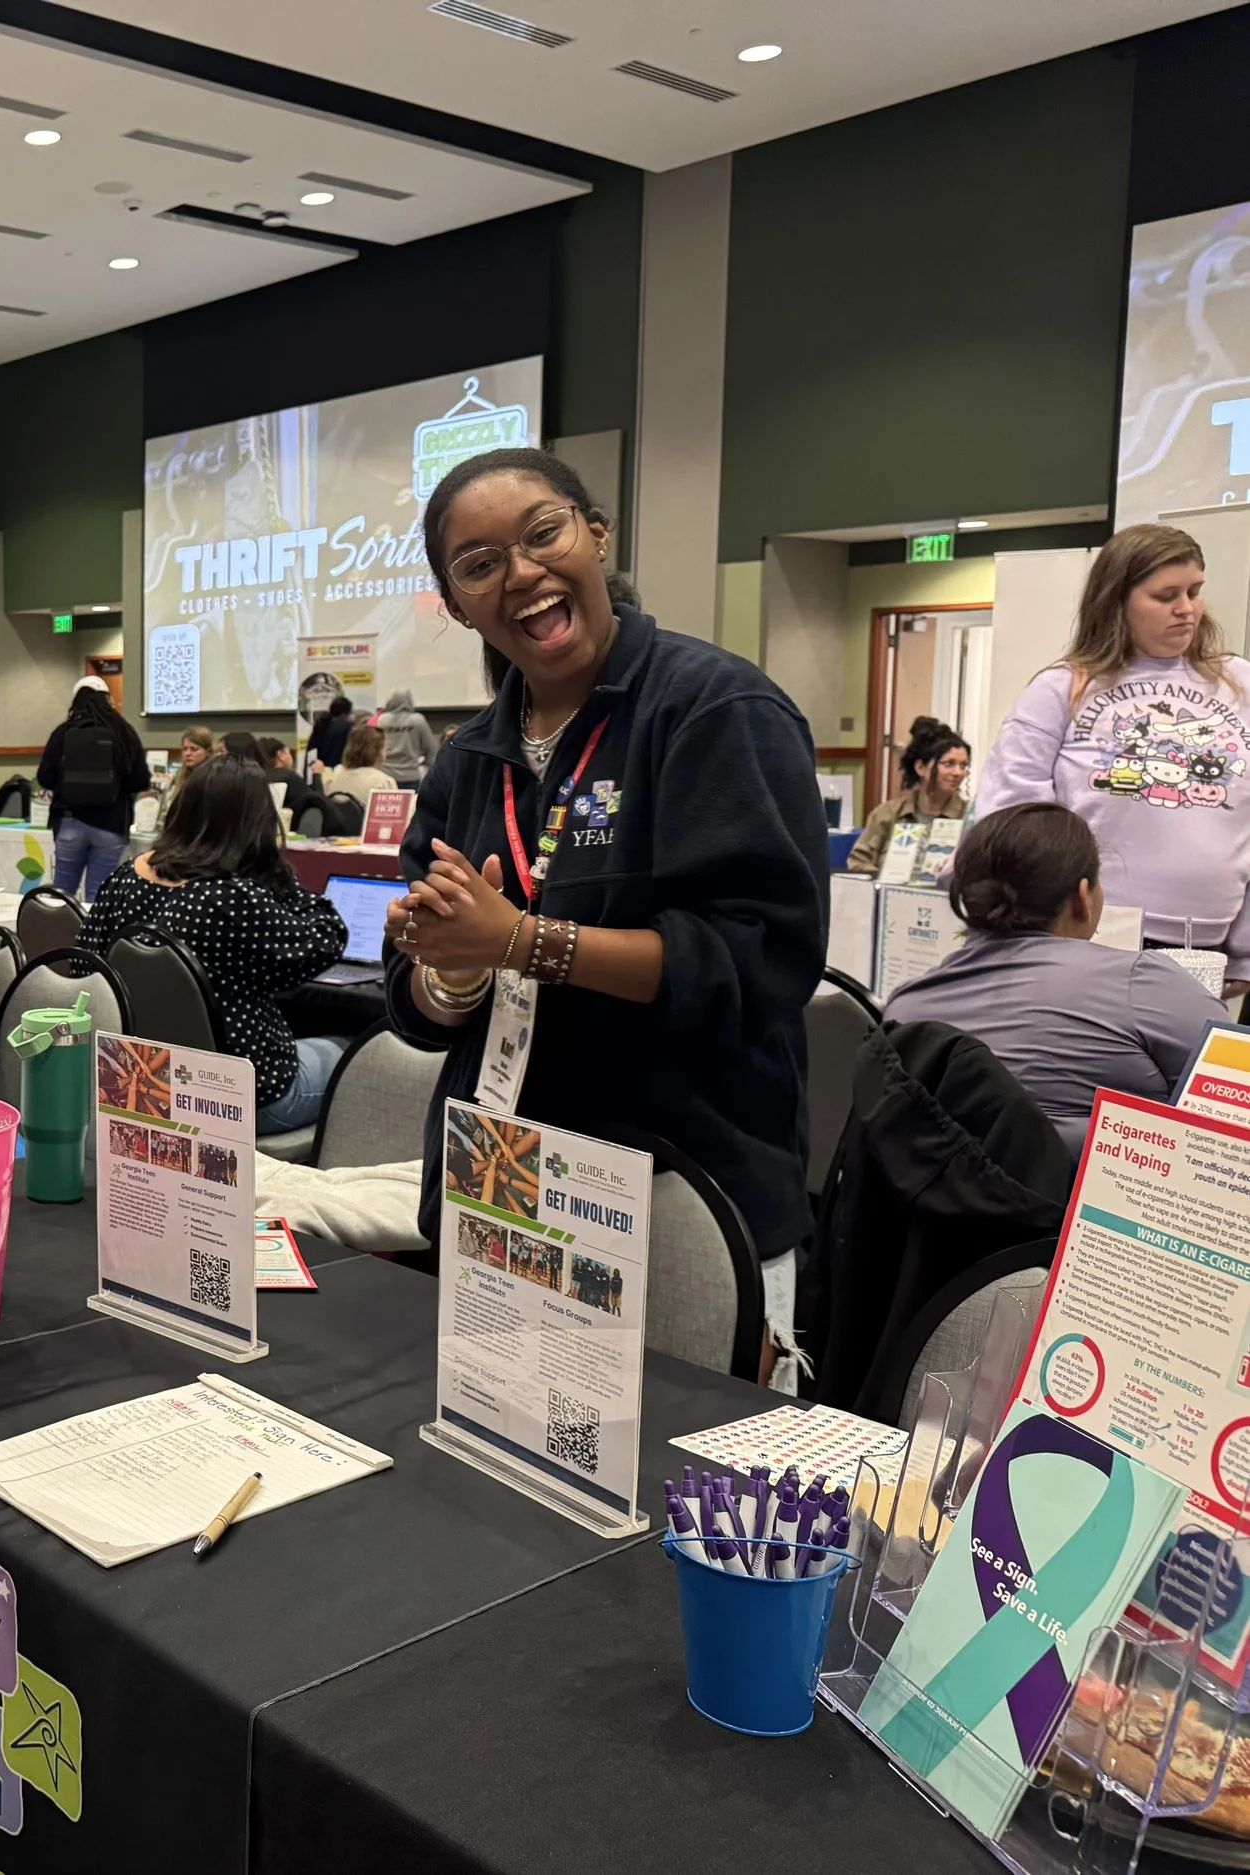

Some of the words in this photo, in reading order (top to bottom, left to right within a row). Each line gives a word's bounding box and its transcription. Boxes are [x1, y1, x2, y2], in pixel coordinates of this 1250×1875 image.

[423, 416, 518, 455] GRIZZLY
[175, 527, 327, 593] THRIFT
[912, 535, 950, 561] EXIT
[179, 594, 237, 615] CLOTHES
[257, 589, 302, 607] SHOES
[307, 645, 369, 656] SPECTRUM
[1163, 684, 1203, 705] AND
[198, 1069, 221, 1083] GUIDE,
[224, 1074, 235, 1085] Inc.
[176, 1093, 191, 1110] GET
[195, 1097, 241, 1122] INVOLVED!
[1100, 1115, 1176, 1149] E-cigarettes
[121, 1162, 139, 1173] Georgia
[141, 1168, 155, 1177] Teen
[1095, 1141, 1121, 1157] and
[1123, 1146, 1171, 1177] Vaping
[127, 1173, 148, 1184] Institute
[577, 1161, 607, 1182] GUIDE,
[610, 1171, 626, 1186] Inc.
[181, 1182, 201, 1194] General
[203, 1189, 225, 1201] Support
[1101, 1166, 1116, 1179] Today,
[1118, 1174, 1132, 1182] more
[1133, 1179, 1152, 1189] middle
[1153, 1185, 1164, 1193] and
[1164, 1188, 1178, 1198] high
[1178, 1194, 1198, 1204] school
[1198, 1200, 1224, 1213] students
[545, 1187, 565, 1212] GET
[570, 1195, 632, 1235] INVOLVED!
[1125, 1195, 1141, 1206] Those
[1141, 1202, 1154, 1210] who
[1155, 1207, 1167, 1216] vape
[1168, 1211, 1179, 1219] are
[1180, 1214, 1187, 1222] 4x
[1188, 1218, 1203, 1227] more
[1204, 1222, 1220, 1235] likely
[1228, 1232, 1243, 1241] start
[1135, 1226, 1168, 1247] WHAT
[1168, 1238, 1180, 1252] IS
[1180, 1243, 1198, 1258] AN
[471, 1266, 495, 1282] Georgia
[498, 1277, 514, 1290] Teen
[478, 1280, 505, 1297] Institute
[543, 1299, 563, 1314] Focus
[566, 1308, 591, 1326] Groups
[1070, 1352, 1084, 1363] 63%
[1134, 1358, 1145, 1369] BY
[1147, 1365, 1162, 1377] THE
[1161, 1371, 1205, 1397] NUMBERS:
[1125, 1382, 1135, 1392] 3.6
[1135, 1389, 1157, 1402] million
[224, 1414, 253, 1432] PLEASE
[1187, 1406, 1194, 1414] in
[1194, 1409, 1204, 1418] 20
[235, 1432, 265, 1451] EMAIL:
[264, 1426, 295, 1444] Sign
[1180, 1436, 1187, 1444] in
[969, 1538, 995, 1563] See
[992, 1556, 1005, 1570] a
[1002, 1560, 1038, 1595] Sign.
[991, 1581, 1028, 1614] Save
[1026, 1608, 1039, 1622] a
[1036, 1612, 1067, 1645] Life.
